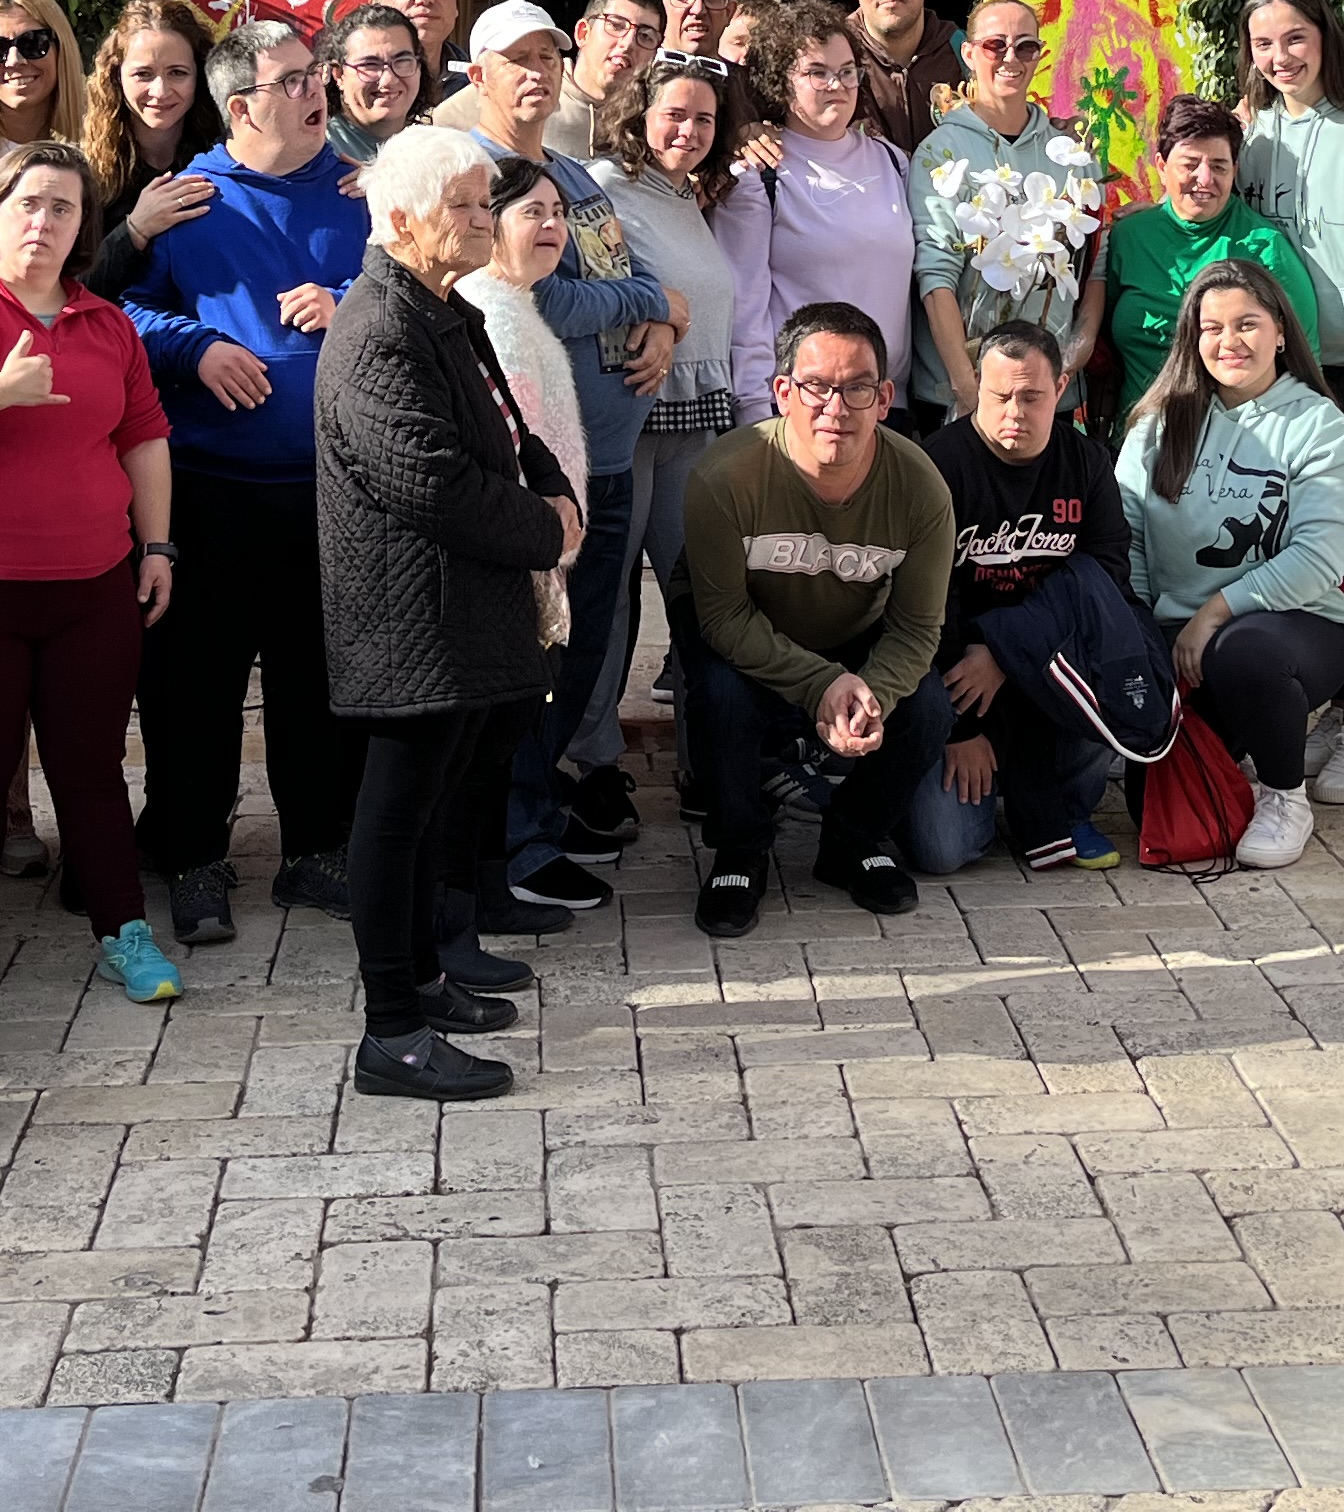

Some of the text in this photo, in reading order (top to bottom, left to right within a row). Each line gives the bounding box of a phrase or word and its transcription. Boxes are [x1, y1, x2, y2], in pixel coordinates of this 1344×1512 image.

[1053, 498, 1083, 524] 90
[768, 540, 886, 578] BLACK
[712, 874, 749, 889] PUMA
